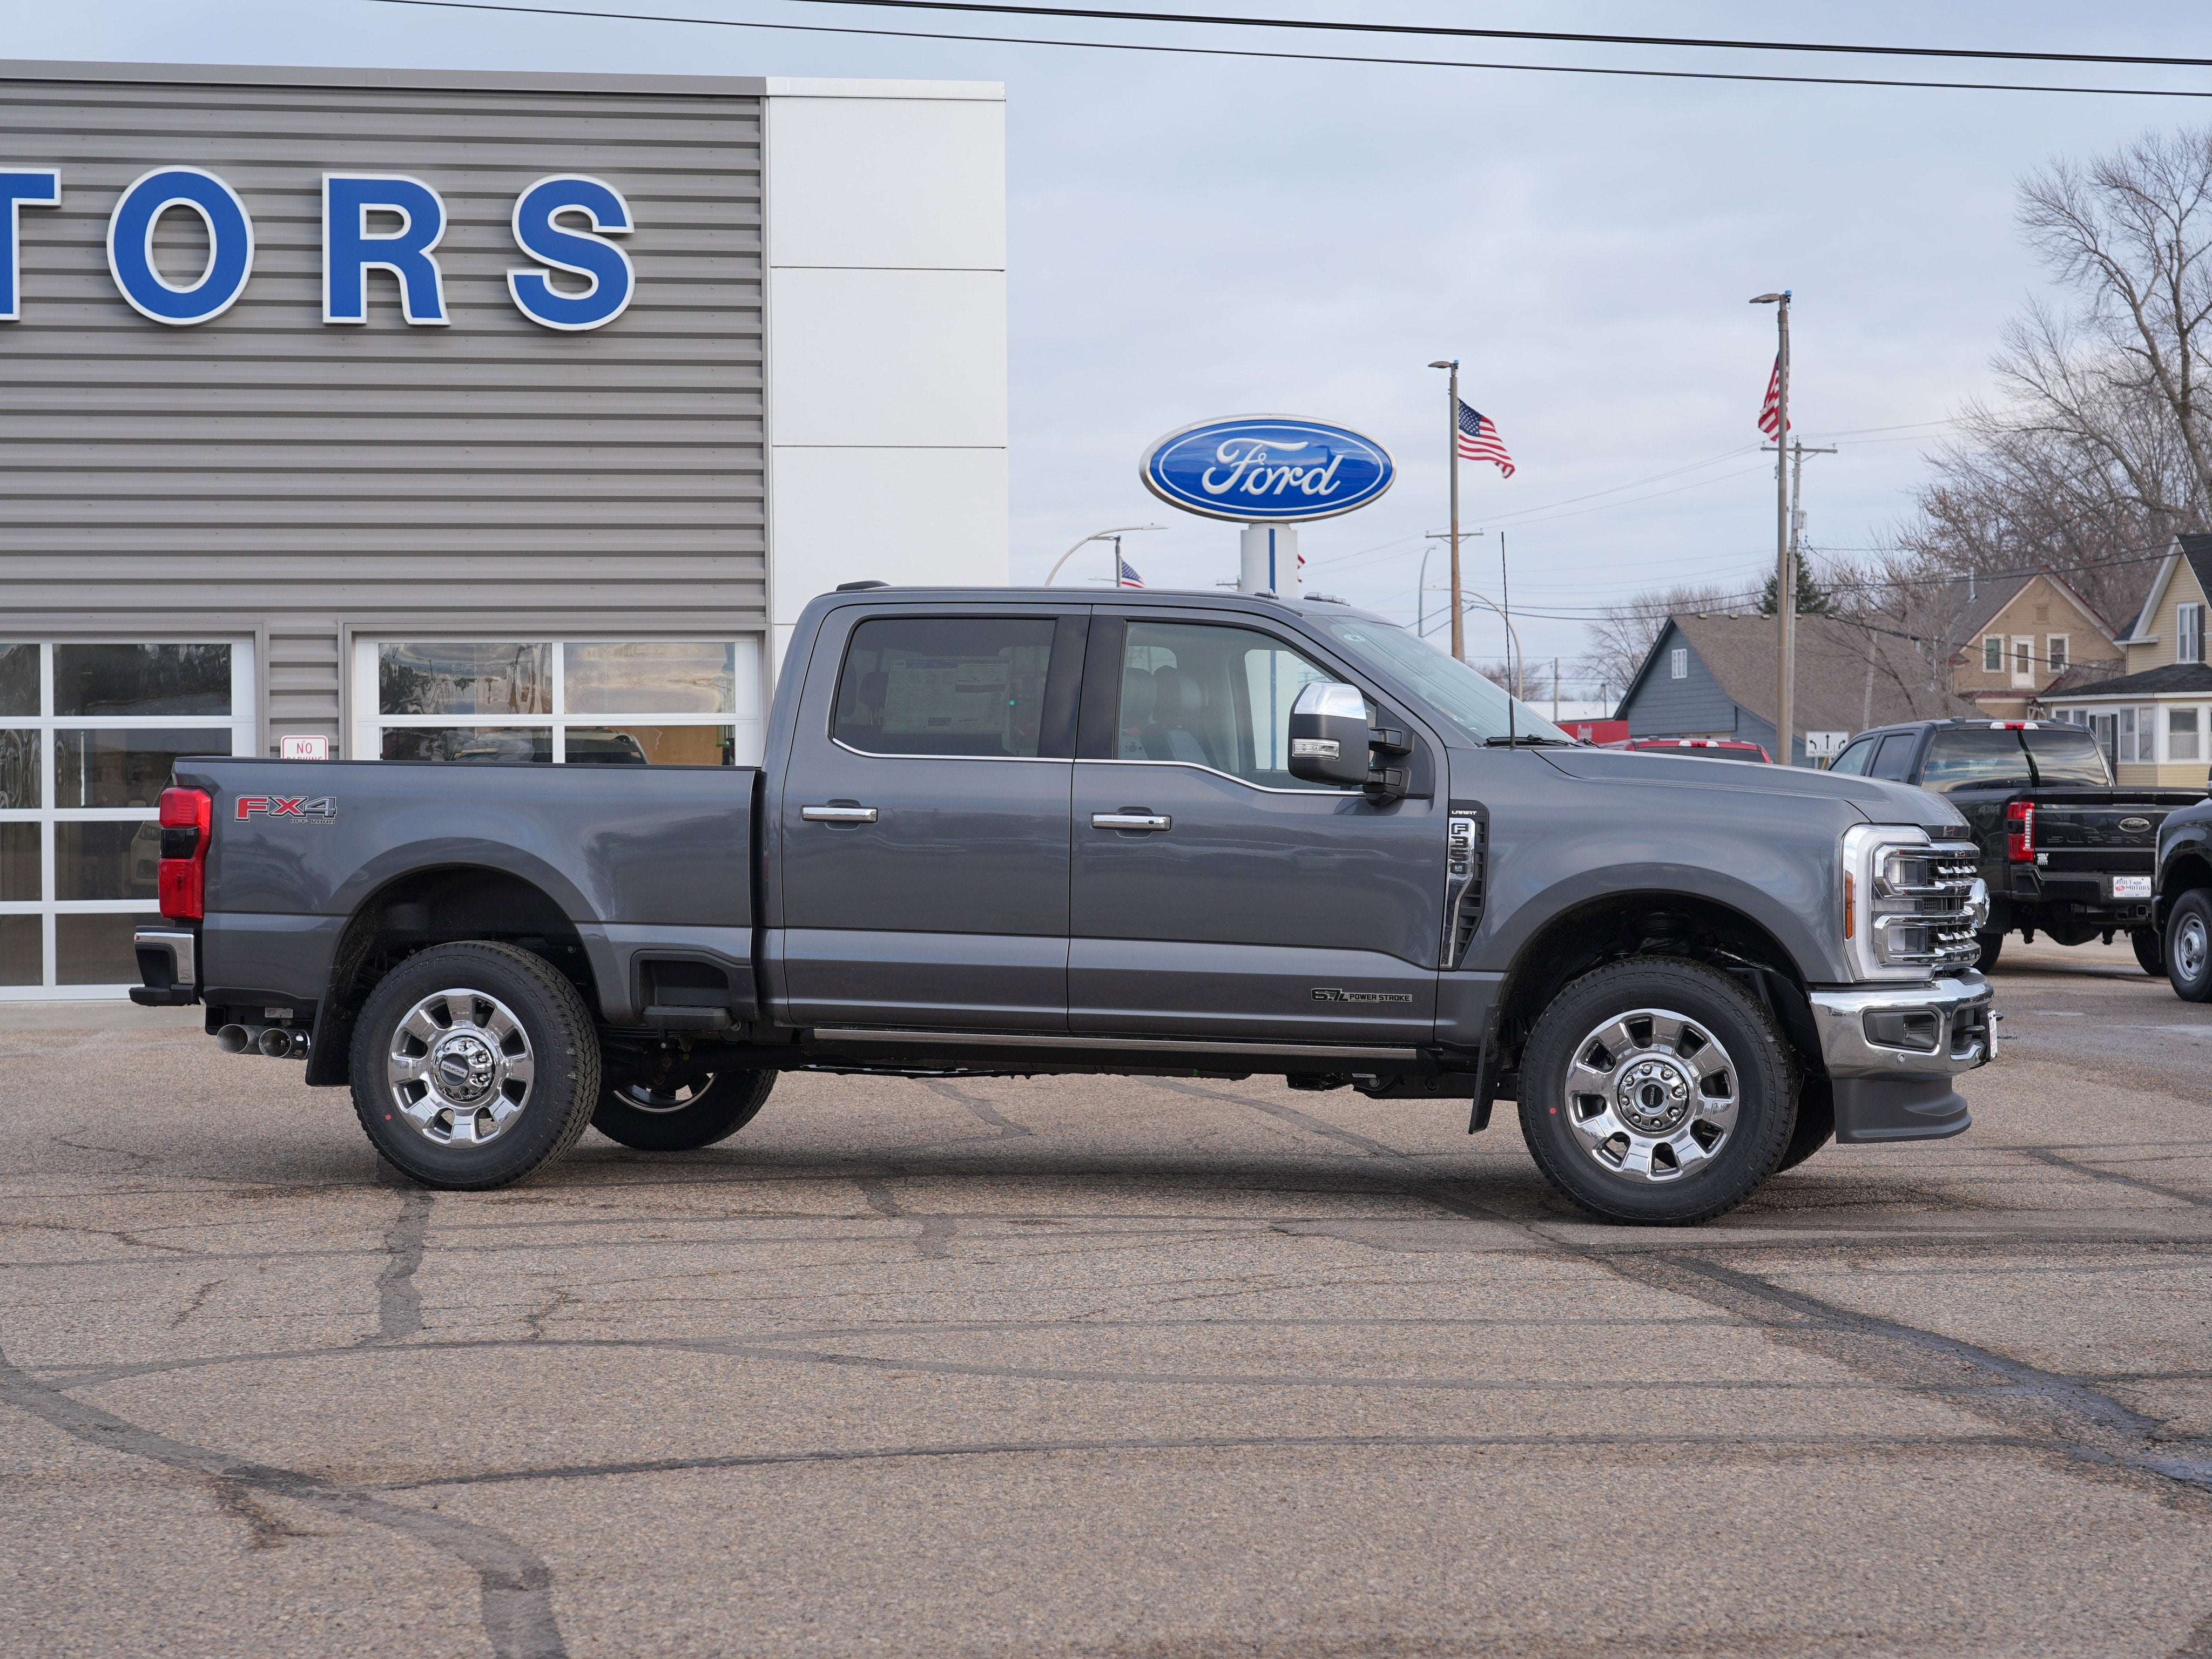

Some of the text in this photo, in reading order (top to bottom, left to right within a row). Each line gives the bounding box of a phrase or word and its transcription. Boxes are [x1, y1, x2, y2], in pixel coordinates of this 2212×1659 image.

[1202, 438, 1344, 495] Ford
[297, 743, 312, 754] NO
[235, 794, 338, 822] FX4
[1311, 988, 1348, 1001] 6.7L
[443, 1064, 464, 1075] FORD
